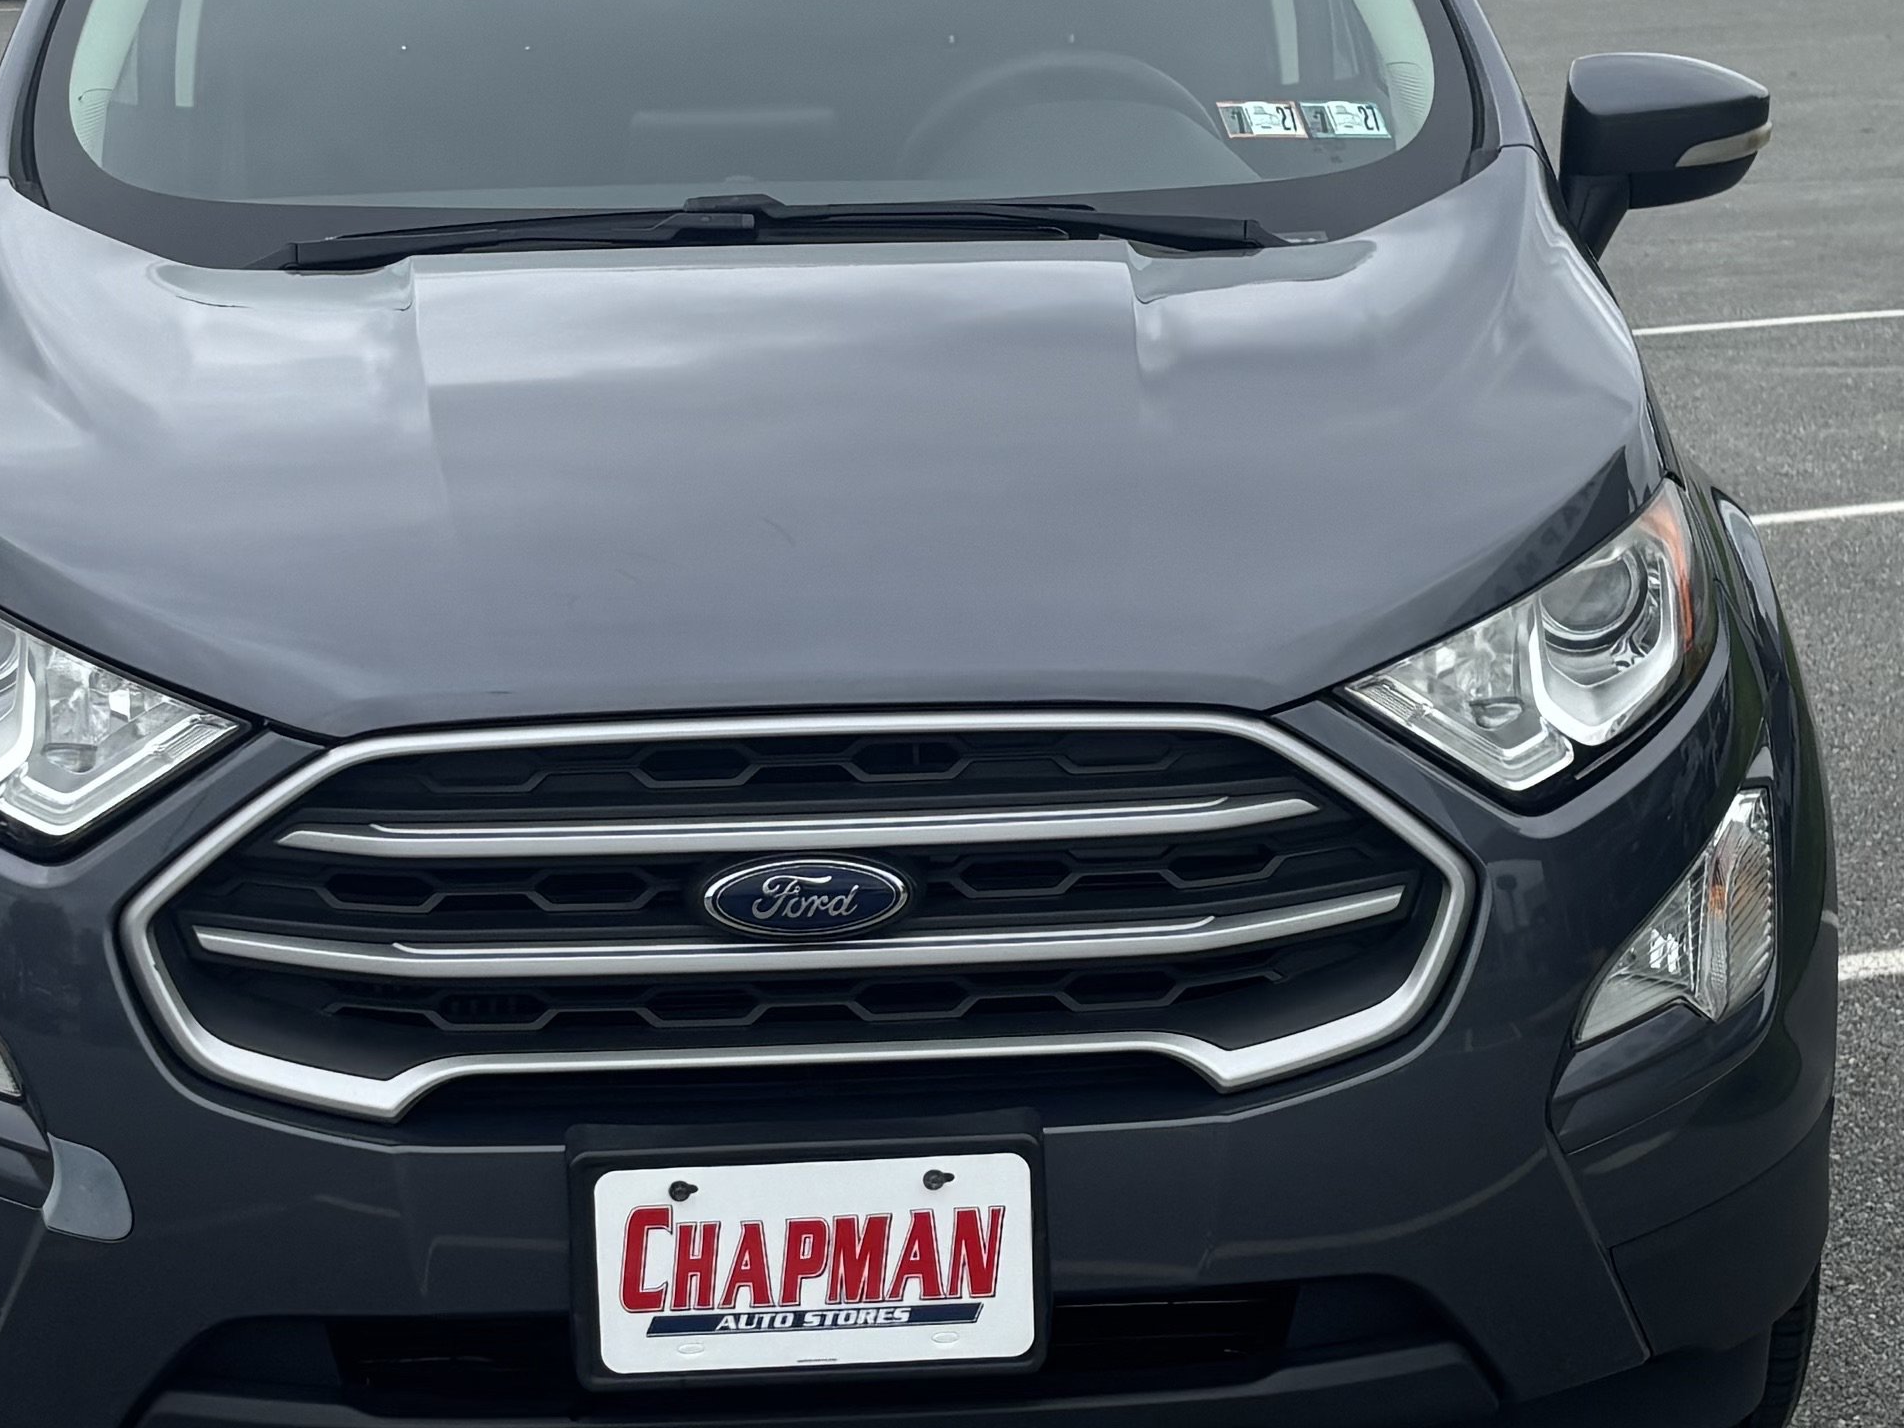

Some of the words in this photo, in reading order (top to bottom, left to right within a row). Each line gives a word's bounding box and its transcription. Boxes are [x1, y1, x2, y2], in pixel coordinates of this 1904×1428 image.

[1275, 105, 1298, 132] 27
[1357, 105, 1381, 131] 27
[751, 875, 859, 920] Ford
[619, 1204, 1007, 1314] CHAPMAN
[714, 1311, 789, 1332] AUTO
[801, 1307, 911, 1328] STORES
